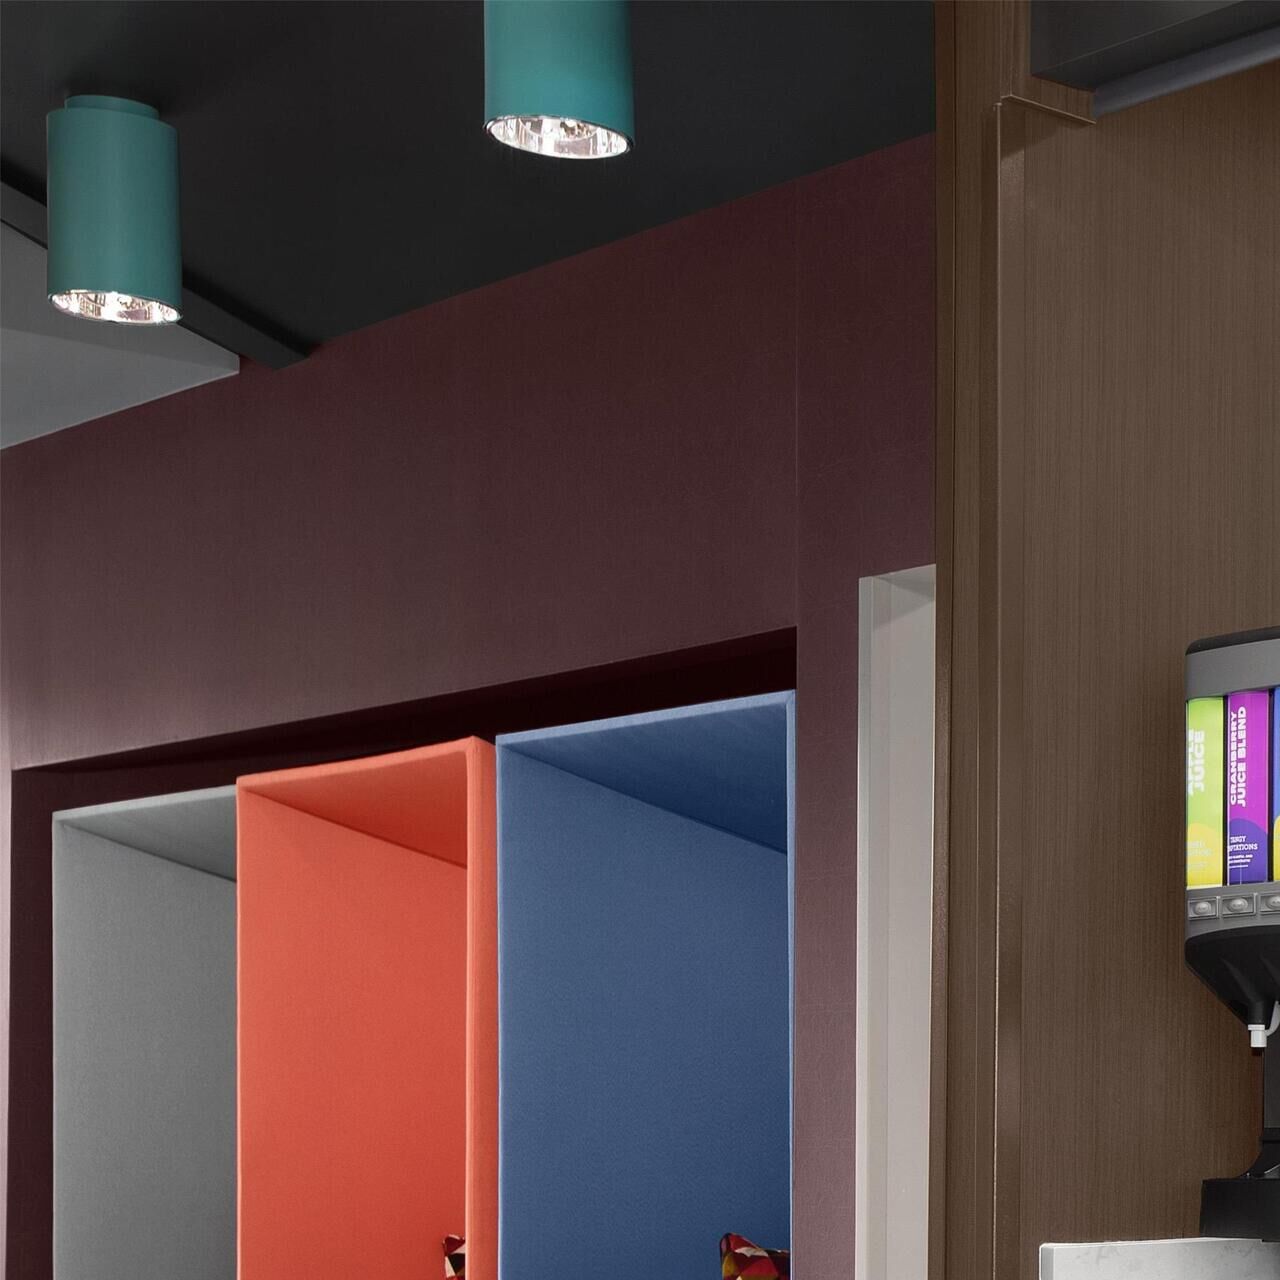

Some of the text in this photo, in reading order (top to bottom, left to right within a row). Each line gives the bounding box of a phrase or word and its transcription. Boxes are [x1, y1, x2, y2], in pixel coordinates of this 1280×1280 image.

[1194, 730, 1205, 792] JUICE
[1238, 706, 1247, 808] JUICE BLEND
